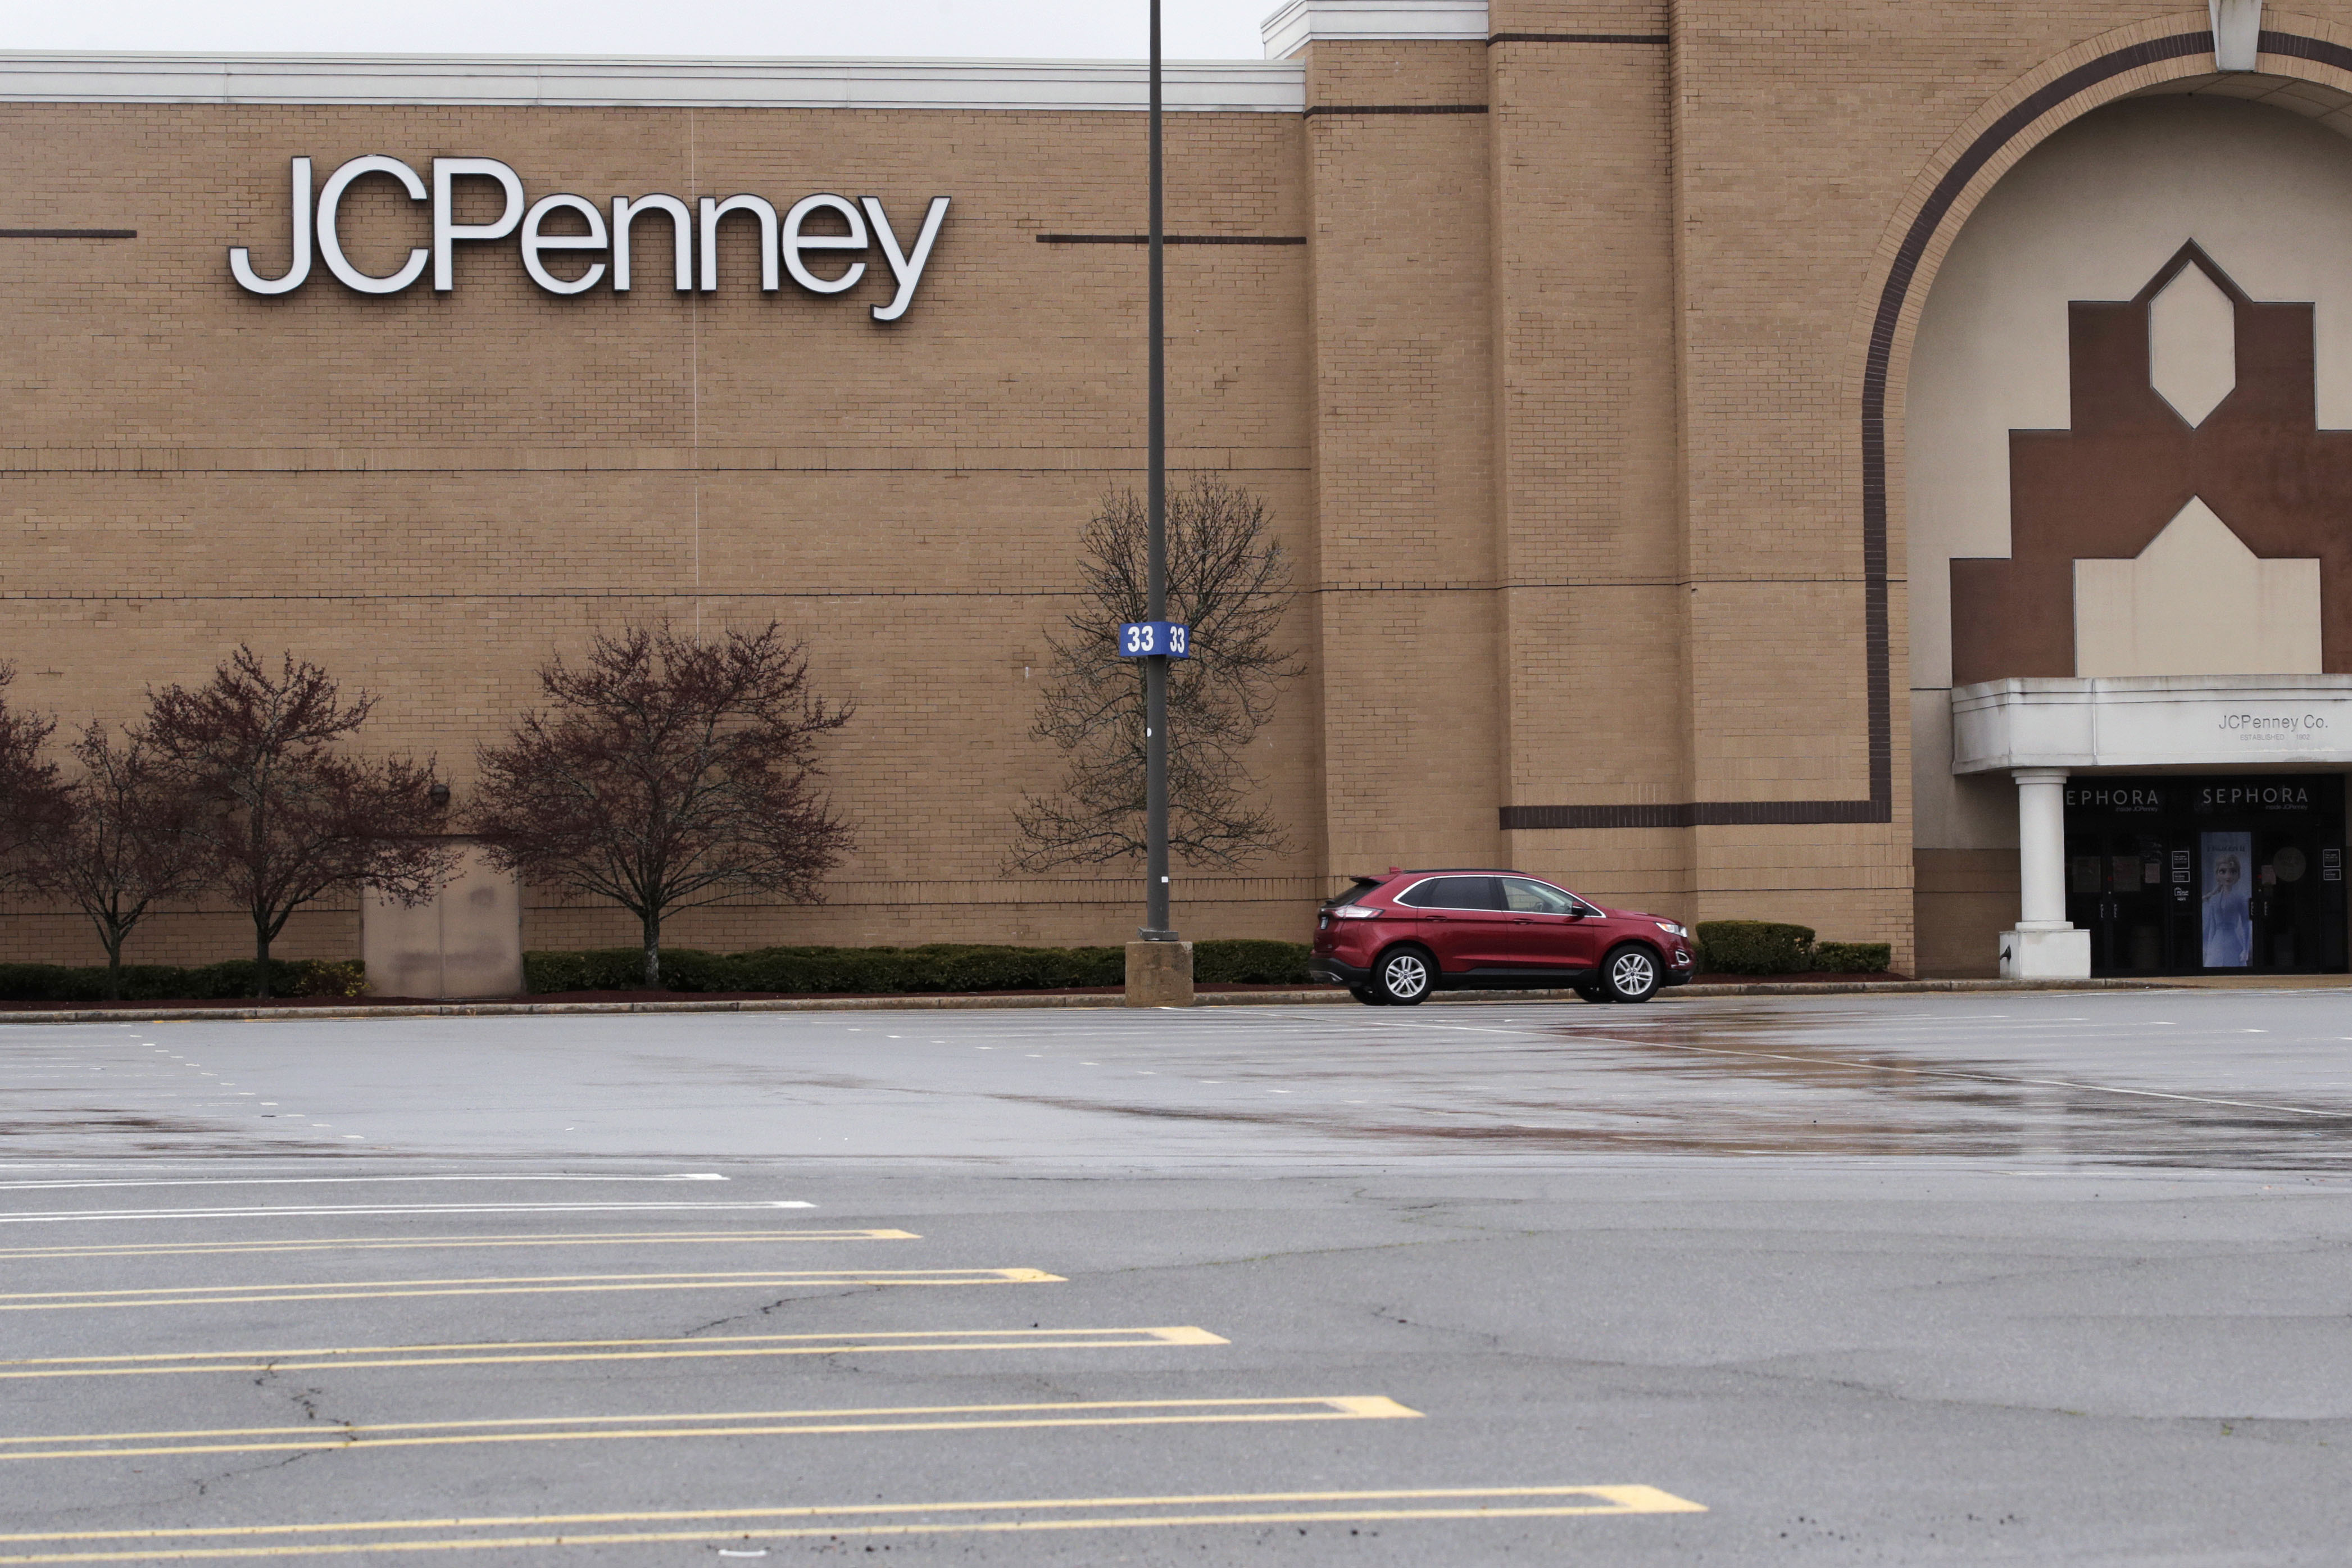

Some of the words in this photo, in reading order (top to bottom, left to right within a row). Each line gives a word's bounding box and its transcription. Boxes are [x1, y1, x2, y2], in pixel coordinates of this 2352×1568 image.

[229, 154, 951, 322] JCPenney
[1127, 625, 1154, 652] 33
[1169, 626, 1185, 653] 33
[2218, 715, 2299, 732] JCPenney
[2303, 714, 2328, 729] Co.
[2066, 789, 2159, 805] EPHORA
[2203, 788, 2308, 803] SEPHORA
